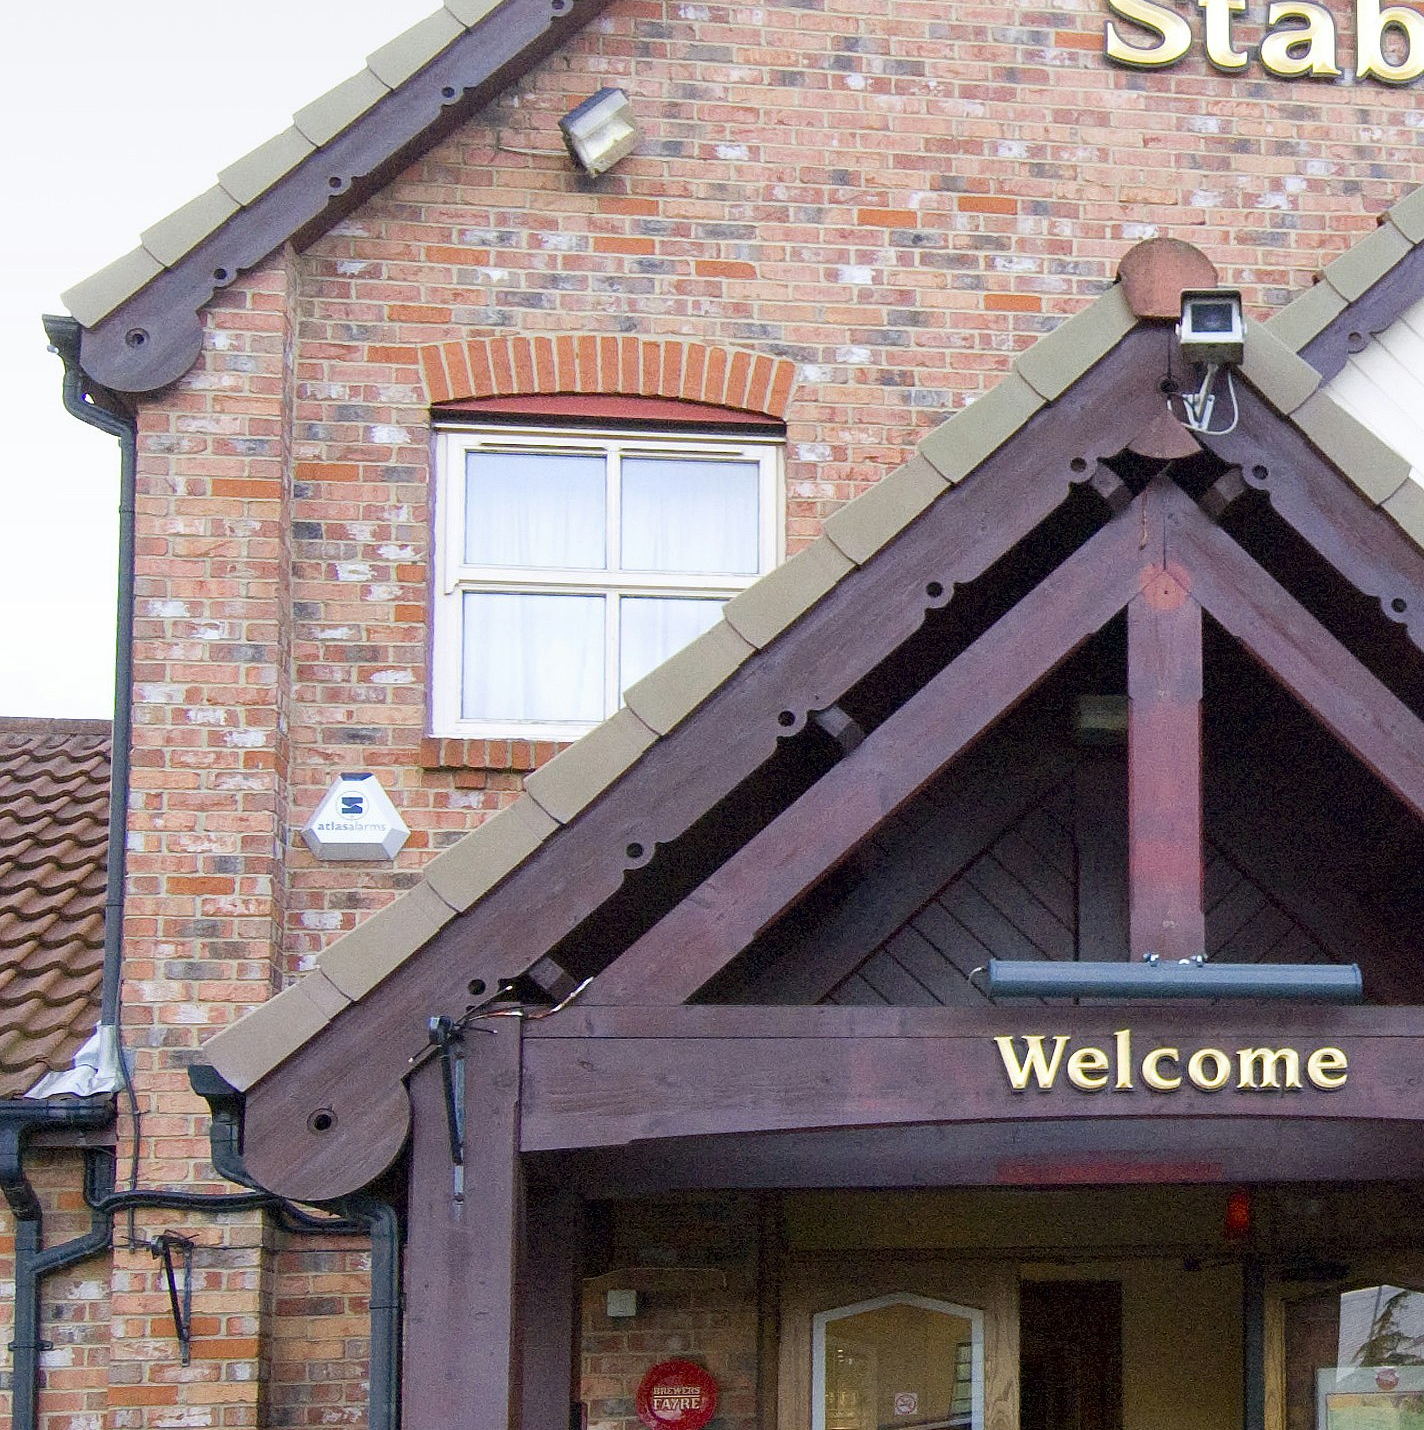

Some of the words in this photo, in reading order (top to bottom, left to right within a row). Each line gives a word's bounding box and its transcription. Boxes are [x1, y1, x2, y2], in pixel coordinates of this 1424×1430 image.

[993, 1028, 1349, 1091] Welcome
[653, 1386, 700, 1395] BREWERS
[653, 1398, 700, 1410] FAYRE
